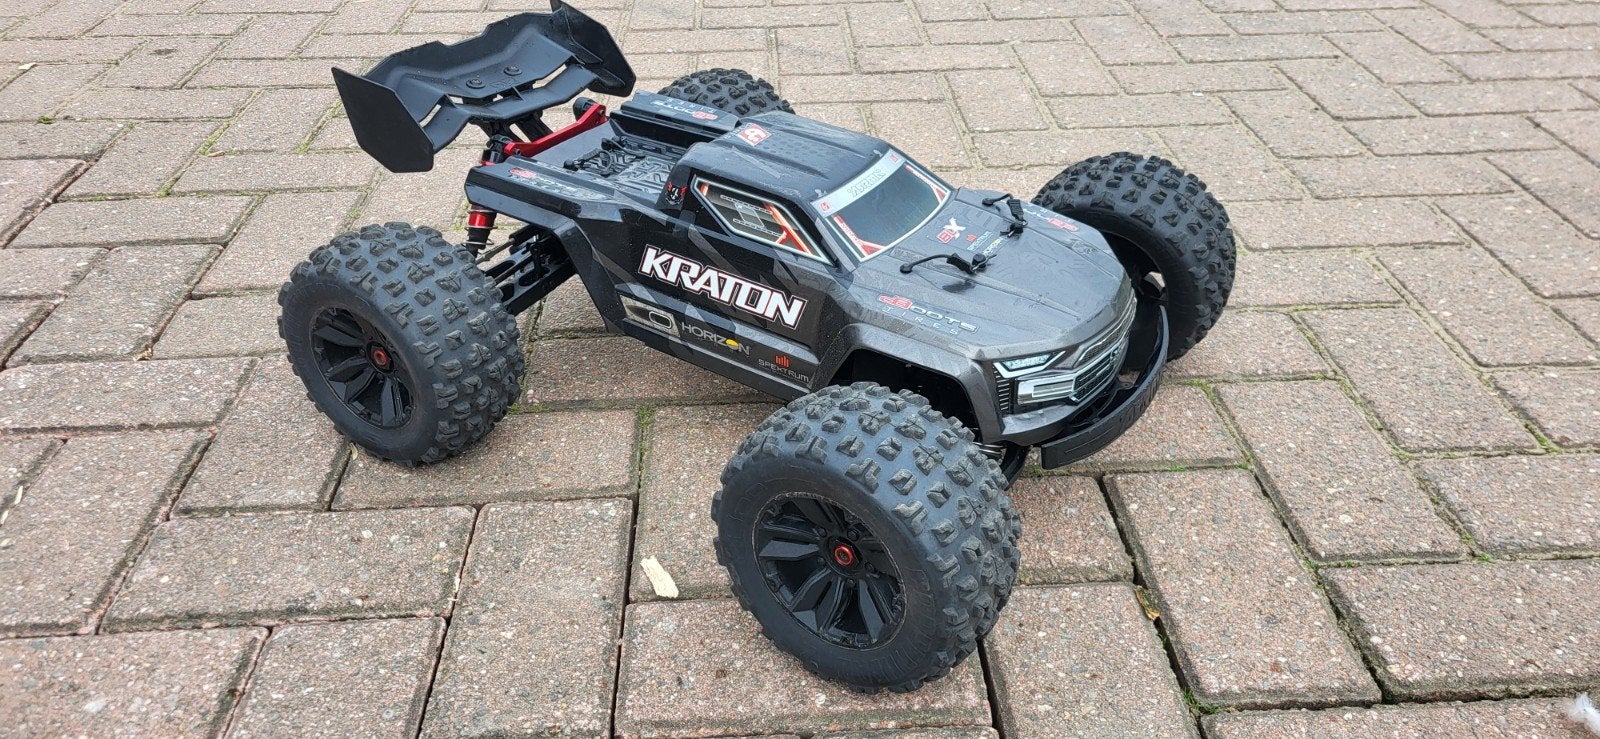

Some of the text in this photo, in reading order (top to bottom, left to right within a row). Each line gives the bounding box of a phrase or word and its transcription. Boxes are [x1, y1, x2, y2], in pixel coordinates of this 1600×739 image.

[638, 243, 808, 330] KRATON
[881, 306, 960, 335] TIRES
[680, 321, 752, 356] HORIZON
[757, 358, 810, 383] SPEKTRUM
